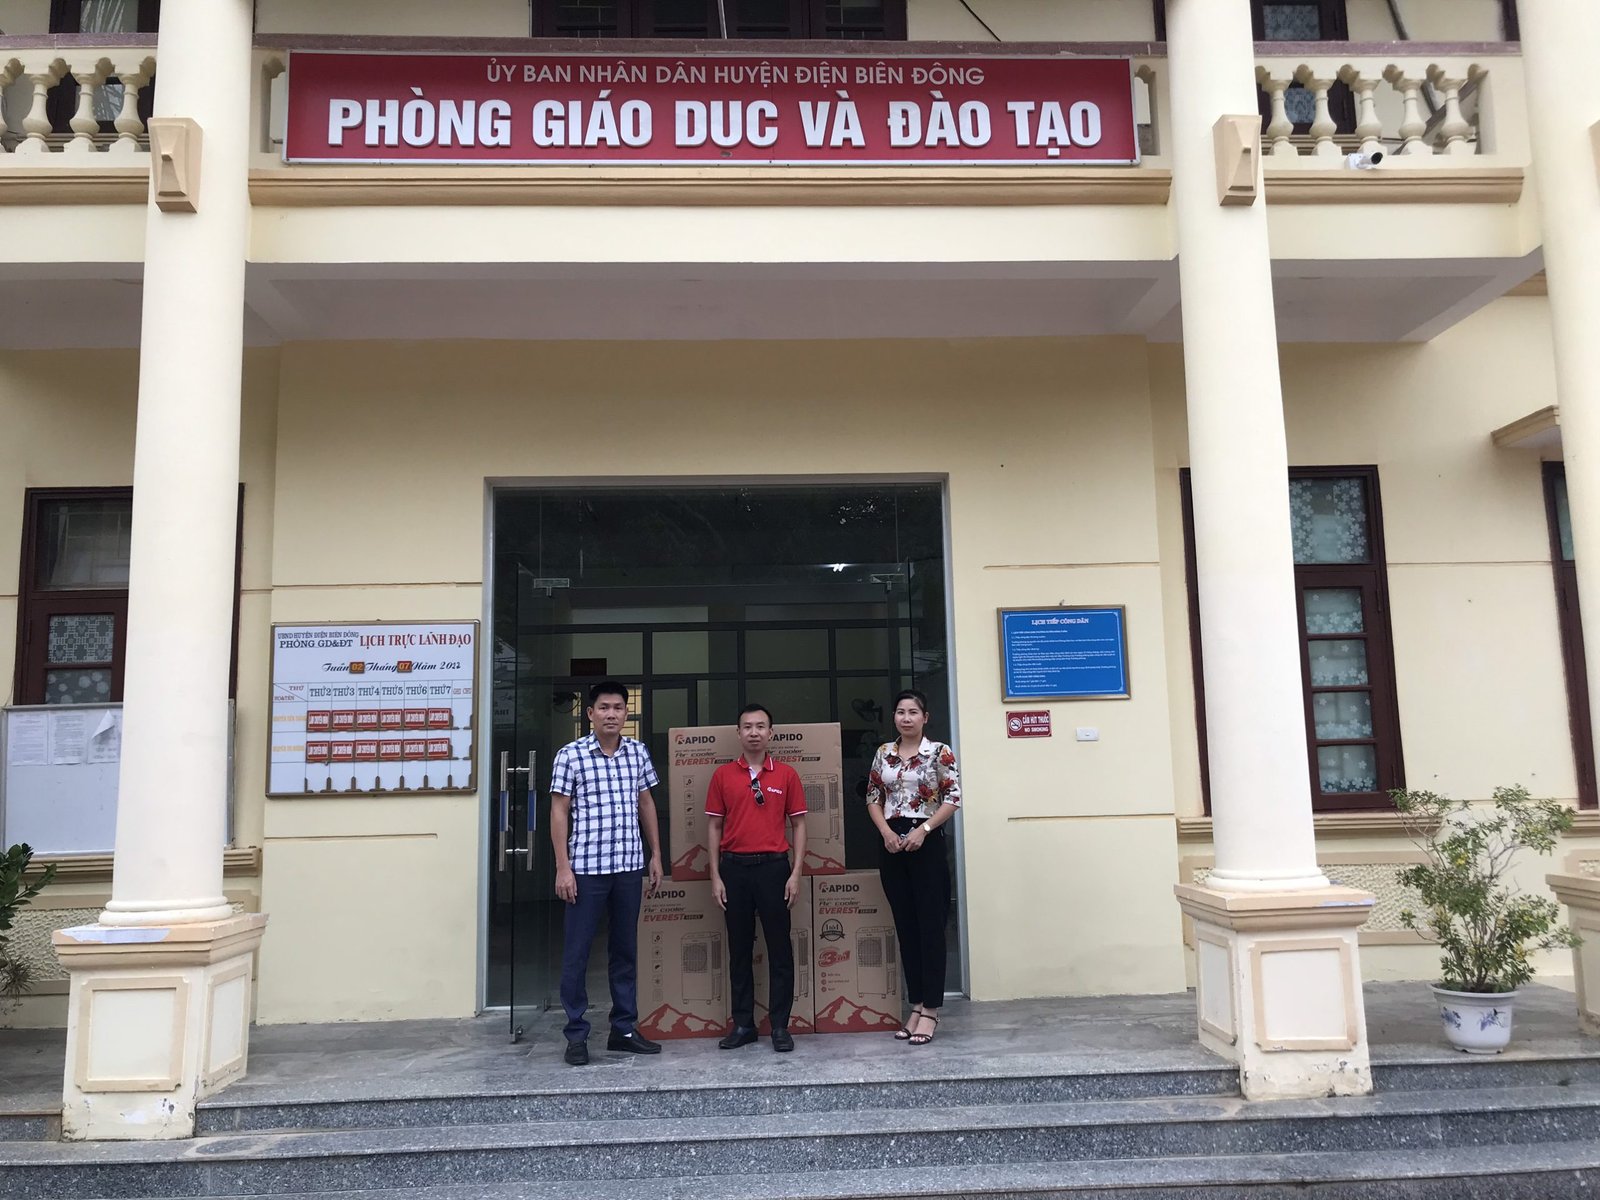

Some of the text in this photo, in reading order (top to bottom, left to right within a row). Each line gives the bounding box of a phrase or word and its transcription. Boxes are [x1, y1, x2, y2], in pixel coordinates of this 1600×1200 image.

[487, 58, 984, 87] ỦY BAN NHÂN DÂN HUYỆN ĐIỆN BIÊN ĐÔNG
[327, 86, 512, 147] PHÒNG
[532, 89, 652, 147] GIÁO
[798, 91, 865, 147] VÀ
[887, 91, 992, 147] ĐÀO
[1007, 101, 1102, 156] TẠO
[280, 639, 315, 648] PHÒNG
[360, 634, 385, 649] LỊCH
[387, 633, 417, 649] TRỰC
[448, 633, 472, 648] ĐẠO
[351, 663, 363, 671] 02
[399, 662, 410, 670] 07
[675, 757, 715, 766] EVEREST
[819, 906, 859, 914] EVEREST
[643, 913, 685, 922] EVEREST
